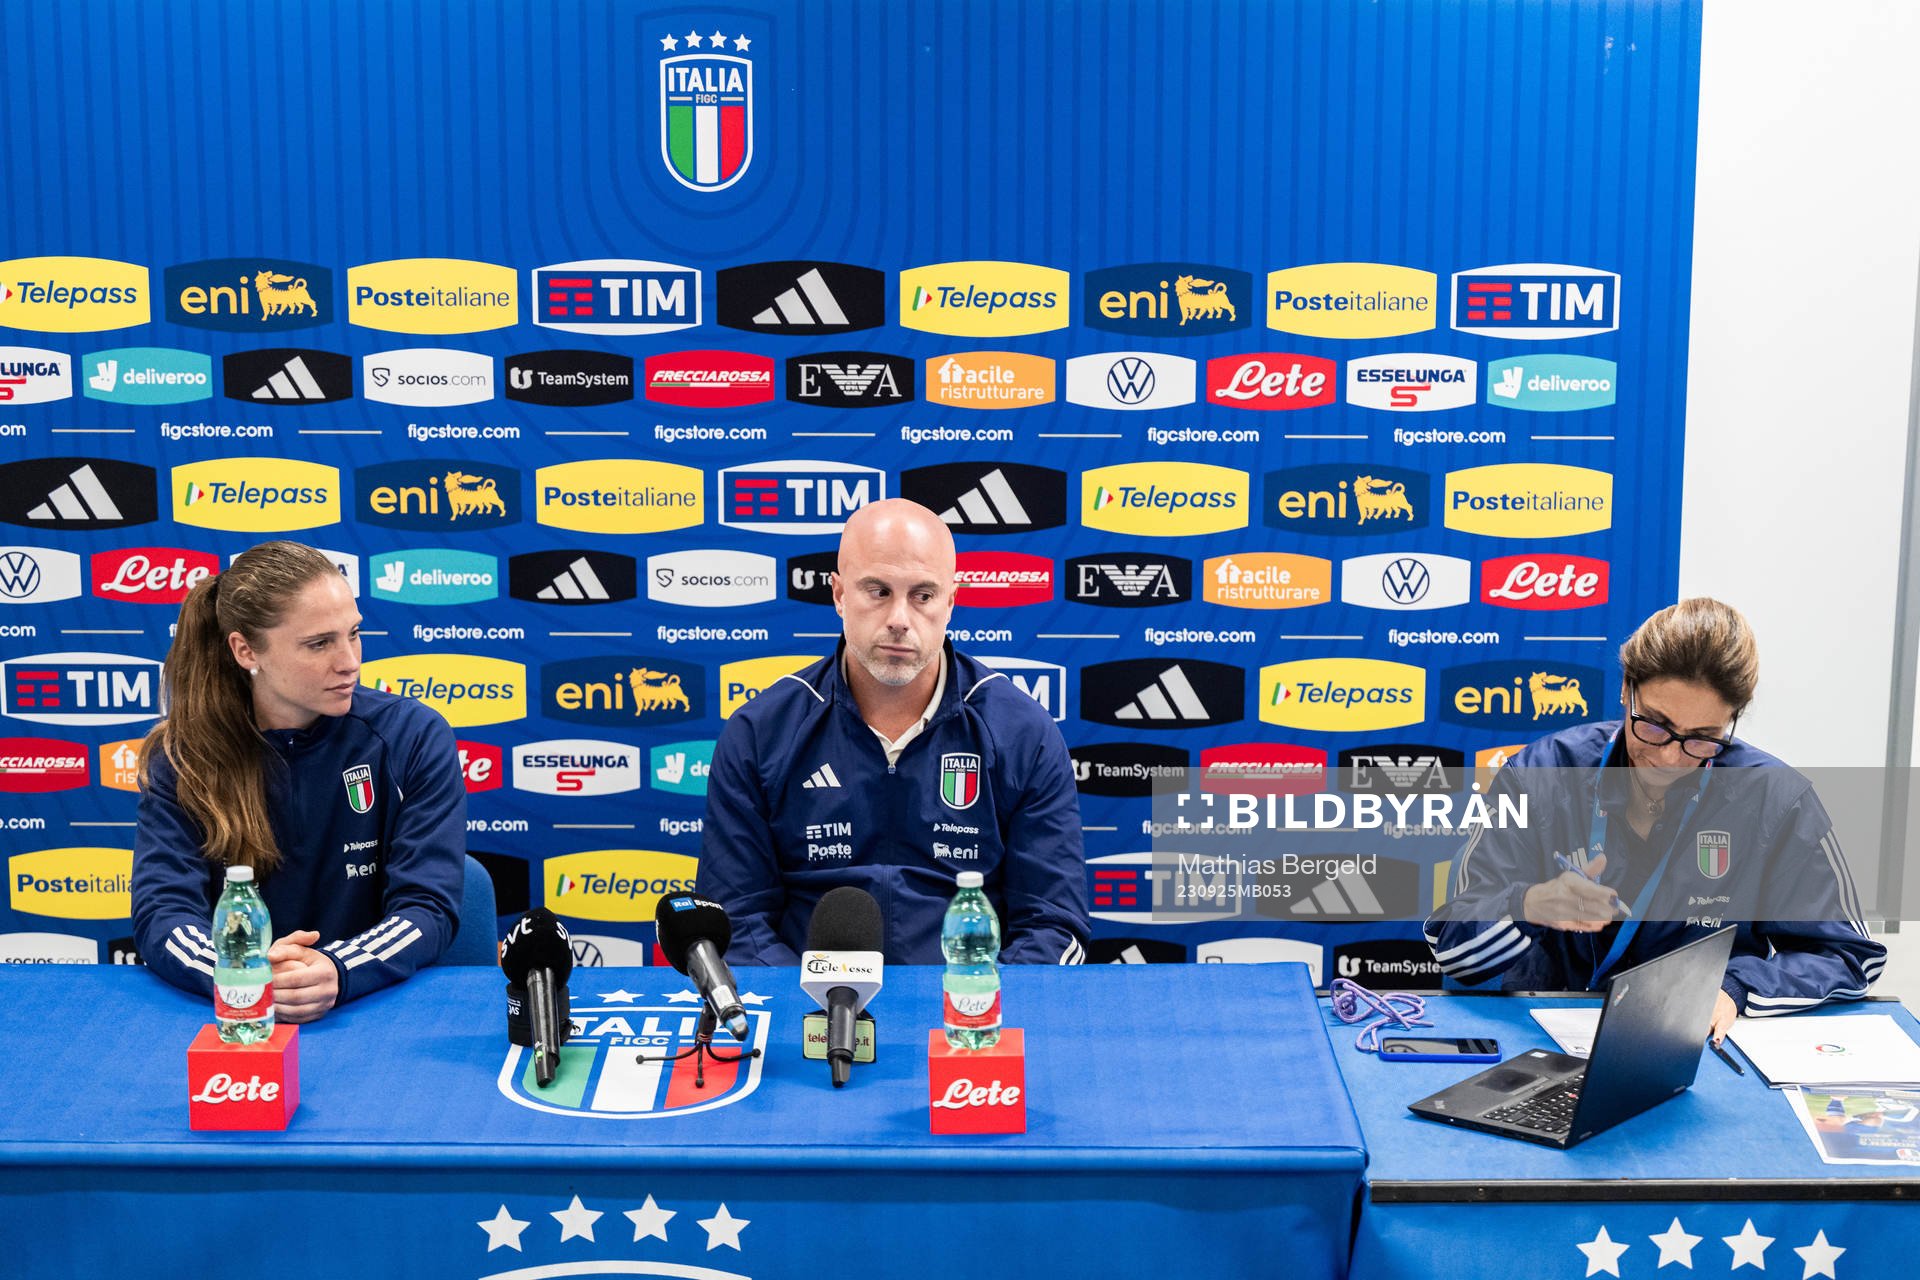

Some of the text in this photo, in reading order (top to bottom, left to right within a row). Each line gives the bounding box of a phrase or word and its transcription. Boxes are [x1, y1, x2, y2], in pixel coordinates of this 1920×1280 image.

[668, 67, 744, 92] ITALIA
[695, 94, 718, 104] FIGC
[16, 281, 138, 309] Telepass
[180, 276, 249, 315] eni
[356, 285, 510, 308] Posteitaliane
[601, 279, 686, 317] TIM
[937, 285, 1057, 314] Telepass
[1099, 280, 1168, 320] eni
[1275, 290, 1429, 312] Posteitaliane
[1520, 283, 1604, 321] TIM
[0, 362, 61, 377] LUNGA
[123, 368, 207, 386] deliveroo
[652, 369, 771, 383] FRECCIAROSSA
[1357, 369, 1466, 383] ESSELUNGA
[398, 372, 487, 387] socios.com
[537, 371, 629, 388] TeamSystem
[1215, 360, 1326, 400] Lete
[1527, 375, 1611, 392] deliveroo
[940, 384, 1045, 399] ristrutturare
[160, 422, 273, 441] figcstore.com
[407, 423, 521, 442] figcstore.com
[654, 424, 767, 443] figcstore.com
[901, 425, 1014, 444] figcstore.com
[1147, 427, 1260, 445] figcstore.com
[1393, 428, 1506, 446] figcstore.com
[209, 480, 328, 509] Telepass
[370, 476, 438, 515] eni
[544, 486, 697, 508] Posteitaliane
[786, 479, 870, 517] TIM
[1118, 485, 1237, 513] Telepass
[1278, 481, 1347, 520] eni
[1452, 491, 1605, 512] Posteitaliane
[101, 556, 210, 594] Lete
[409, 568, 492, 586] deliveroo
[681, 572, 769, 587] socios.com
[953, 570, 1050, 583] ECCIAROSSA
[1489, 561, 1599, 600] Lete
[1217, 584, 1321, 600] ristrutturare
[413, 624, 525, 643] figcstore.com
[657, 625, 769, 644] figcstore.com
[1144, 627, 1256, 646] figcstore.com
[1388, 629, 1500, 647] figcstore.com
[66, 671, 151, 708] TIM
[396, 676, 514, 705] Telepass
[555, 674, 624, 711] eni
[1295, 681, 1414, 709] Telepass
[1454, 677, 1522, 715] eni
[0, 756, 86, 769] CCIAROSSA
[523, 755, 629, 769] ESSELUNGA
[945, 757, 978, 769] ITALIA
[1095, 763, 1185, 779] TeamSystem
[1207, 762, 1324, 775] FRECCIAROSSA
[345, 767, 370, 783] ITALIA
[823, 822, 852, 837] TIM
[941, 823, 980, 835] Telepass
[1699, 834, 1728, 845] ITALIA
[808, 841, 852, 858] Poste
[952, 844, 979, 860] eni
[358, 857, 378, 877] en
[17, 873, 132, 894] Posteitalia
[580, 872, 696, 900] Telepass
[673, 899, 693, 908] Rai
[1365, 959, 1443, 974] TeamSyste
[569, 1016, 740, 1037] TALI
[609, 1036, 670, 1046] FIGC
[191, 1073, 280, 1104] Lete
[932, 1078, 1021, 1109] Lete
